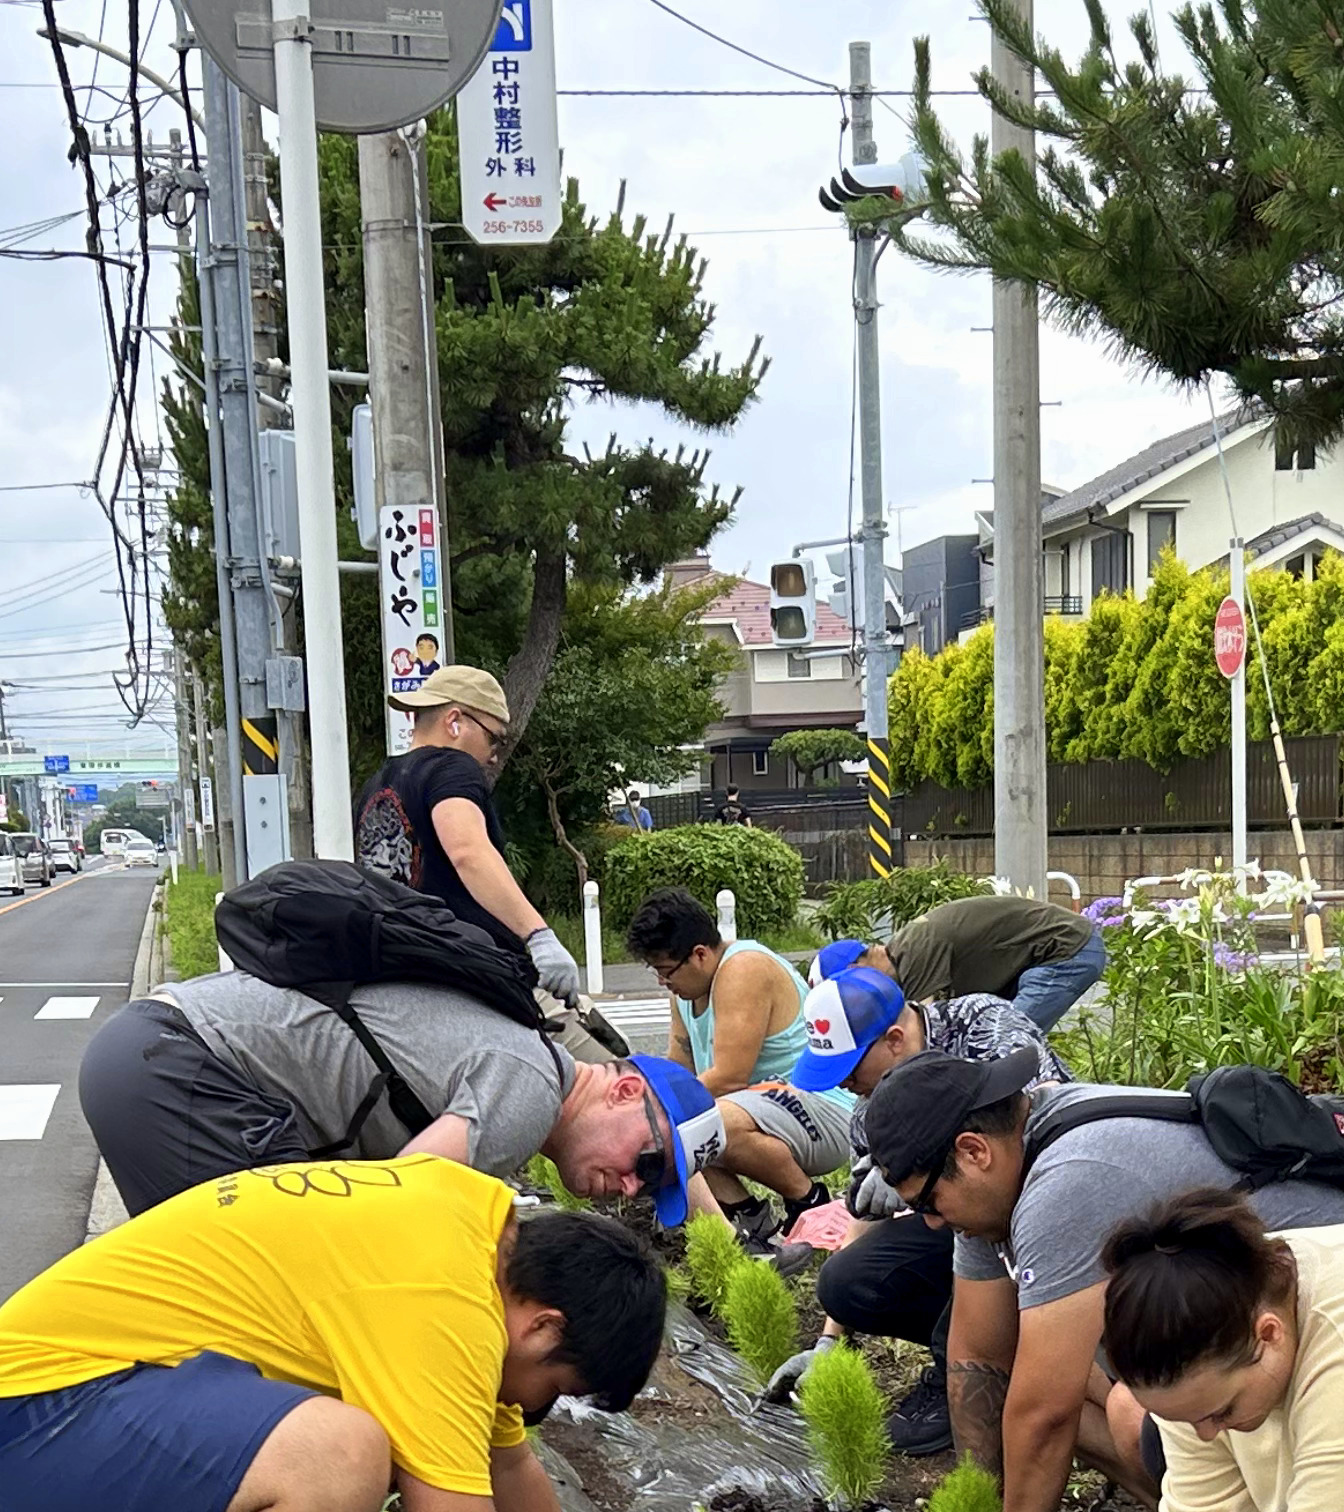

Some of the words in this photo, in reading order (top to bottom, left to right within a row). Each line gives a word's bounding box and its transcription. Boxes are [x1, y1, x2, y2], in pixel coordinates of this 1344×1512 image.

[490, 57, 523, 155] 中村整形
[485, 158, 536, 178] 外科
[483, 219, 544, 233] 256-7355
[385, 510, 418, 628] ふじや
[394, 680, 423, 691] さがみ
[806, 1021, 816, 1035] e
